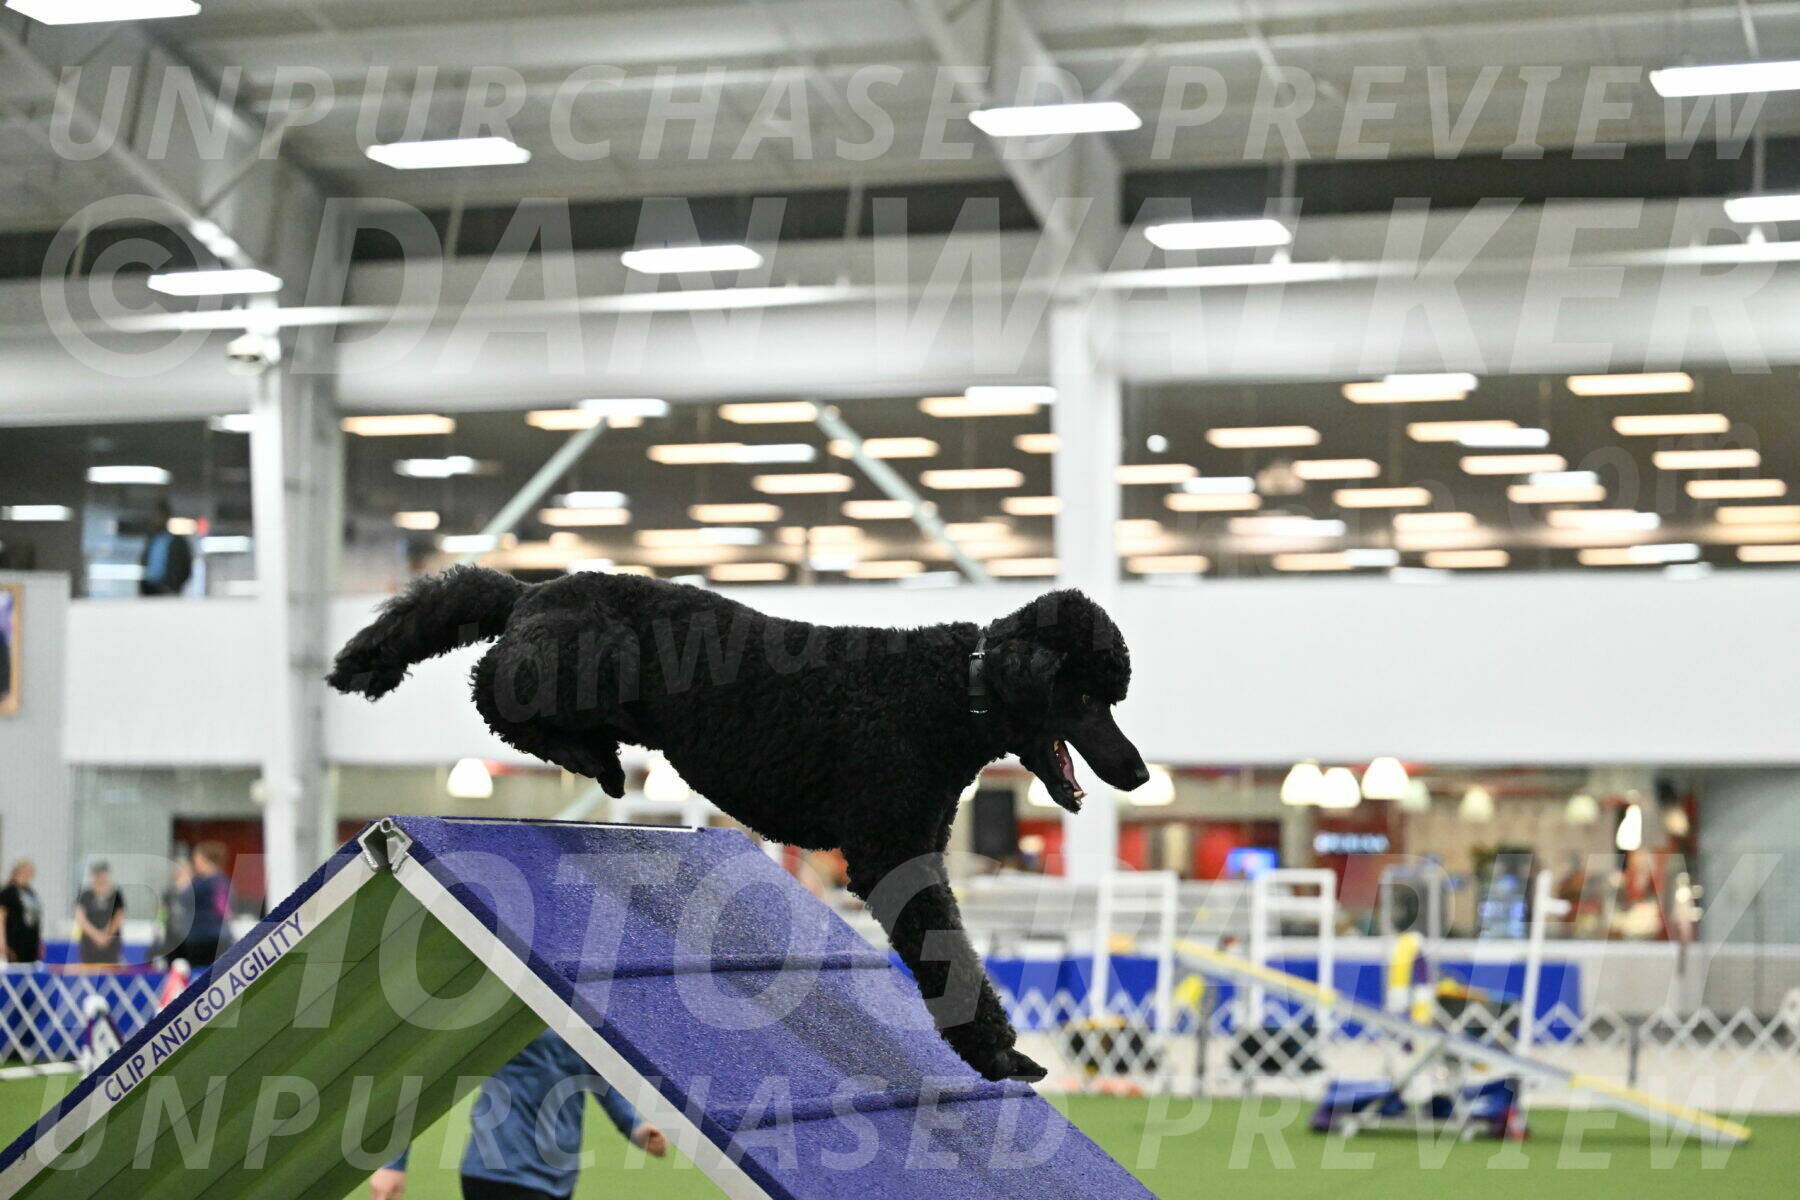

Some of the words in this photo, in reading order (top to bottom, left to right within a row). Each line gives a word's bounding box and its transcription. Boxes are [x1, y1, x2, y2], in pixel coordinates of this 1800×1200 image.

[104, 1054, 146, 1102] CLIP
[150, 1017, 192, 1065] AND
[194, 986, 226, 1022] GO
[228, 911, 304, 996] AGILITY
